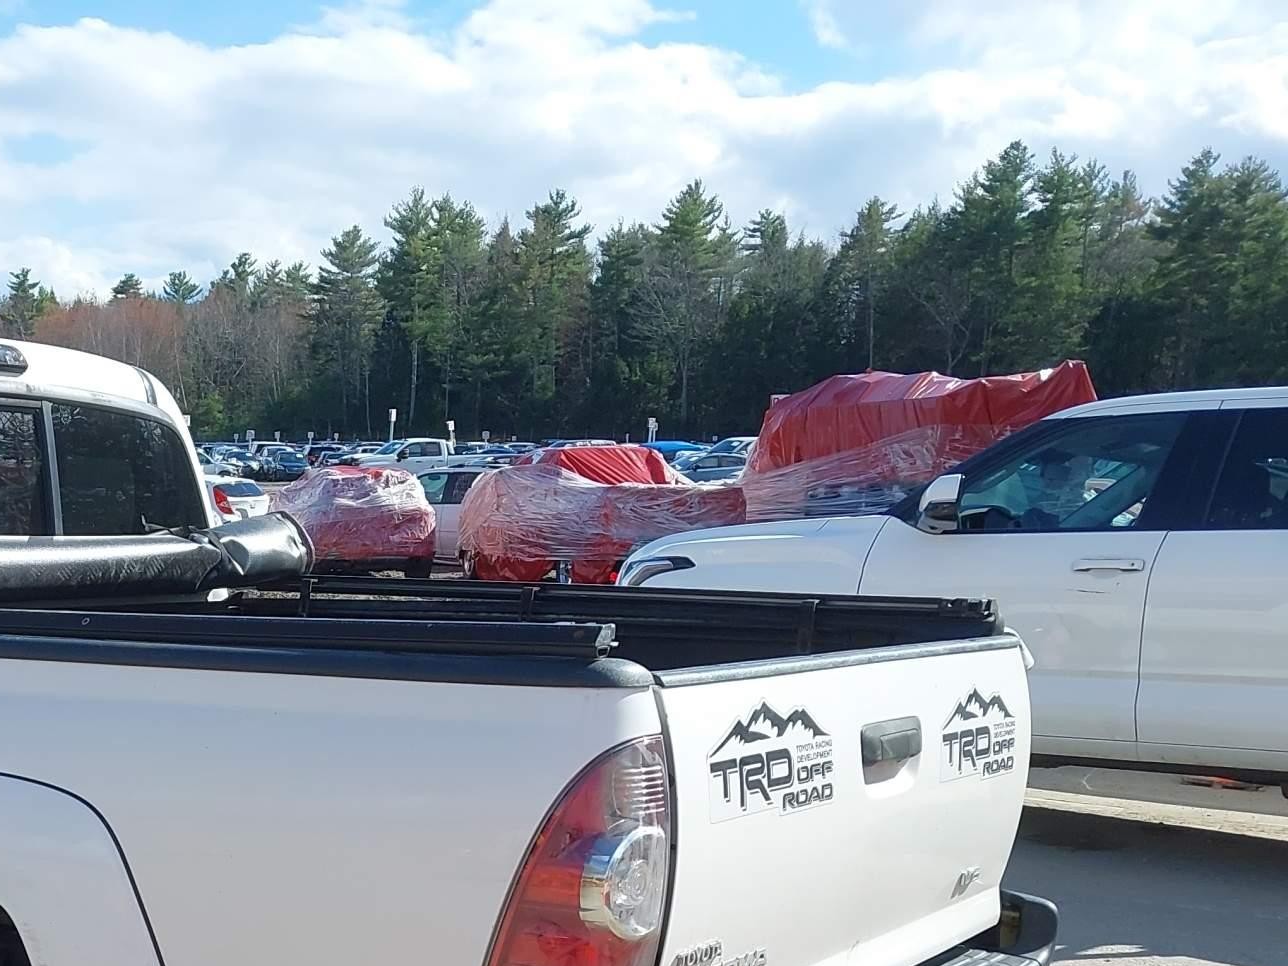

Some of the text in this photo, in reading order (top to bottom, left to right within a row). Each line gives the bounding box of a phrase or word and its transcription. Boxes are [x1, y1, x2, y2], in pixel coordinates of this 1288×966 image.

[796, 739, 833, 753] TOYOTA RACING
[796, 750, 833, 763] DEVELOPMENT
[942, 726, 990, 775] TRD
[993, 738, 1015, 755] OFF
[797, 760, 834, 784] OFF
[982, 756, 1014, 776] ROAD
[710, 748, 794, 812] TRD
[782, 783, 834, 811] ROAD
